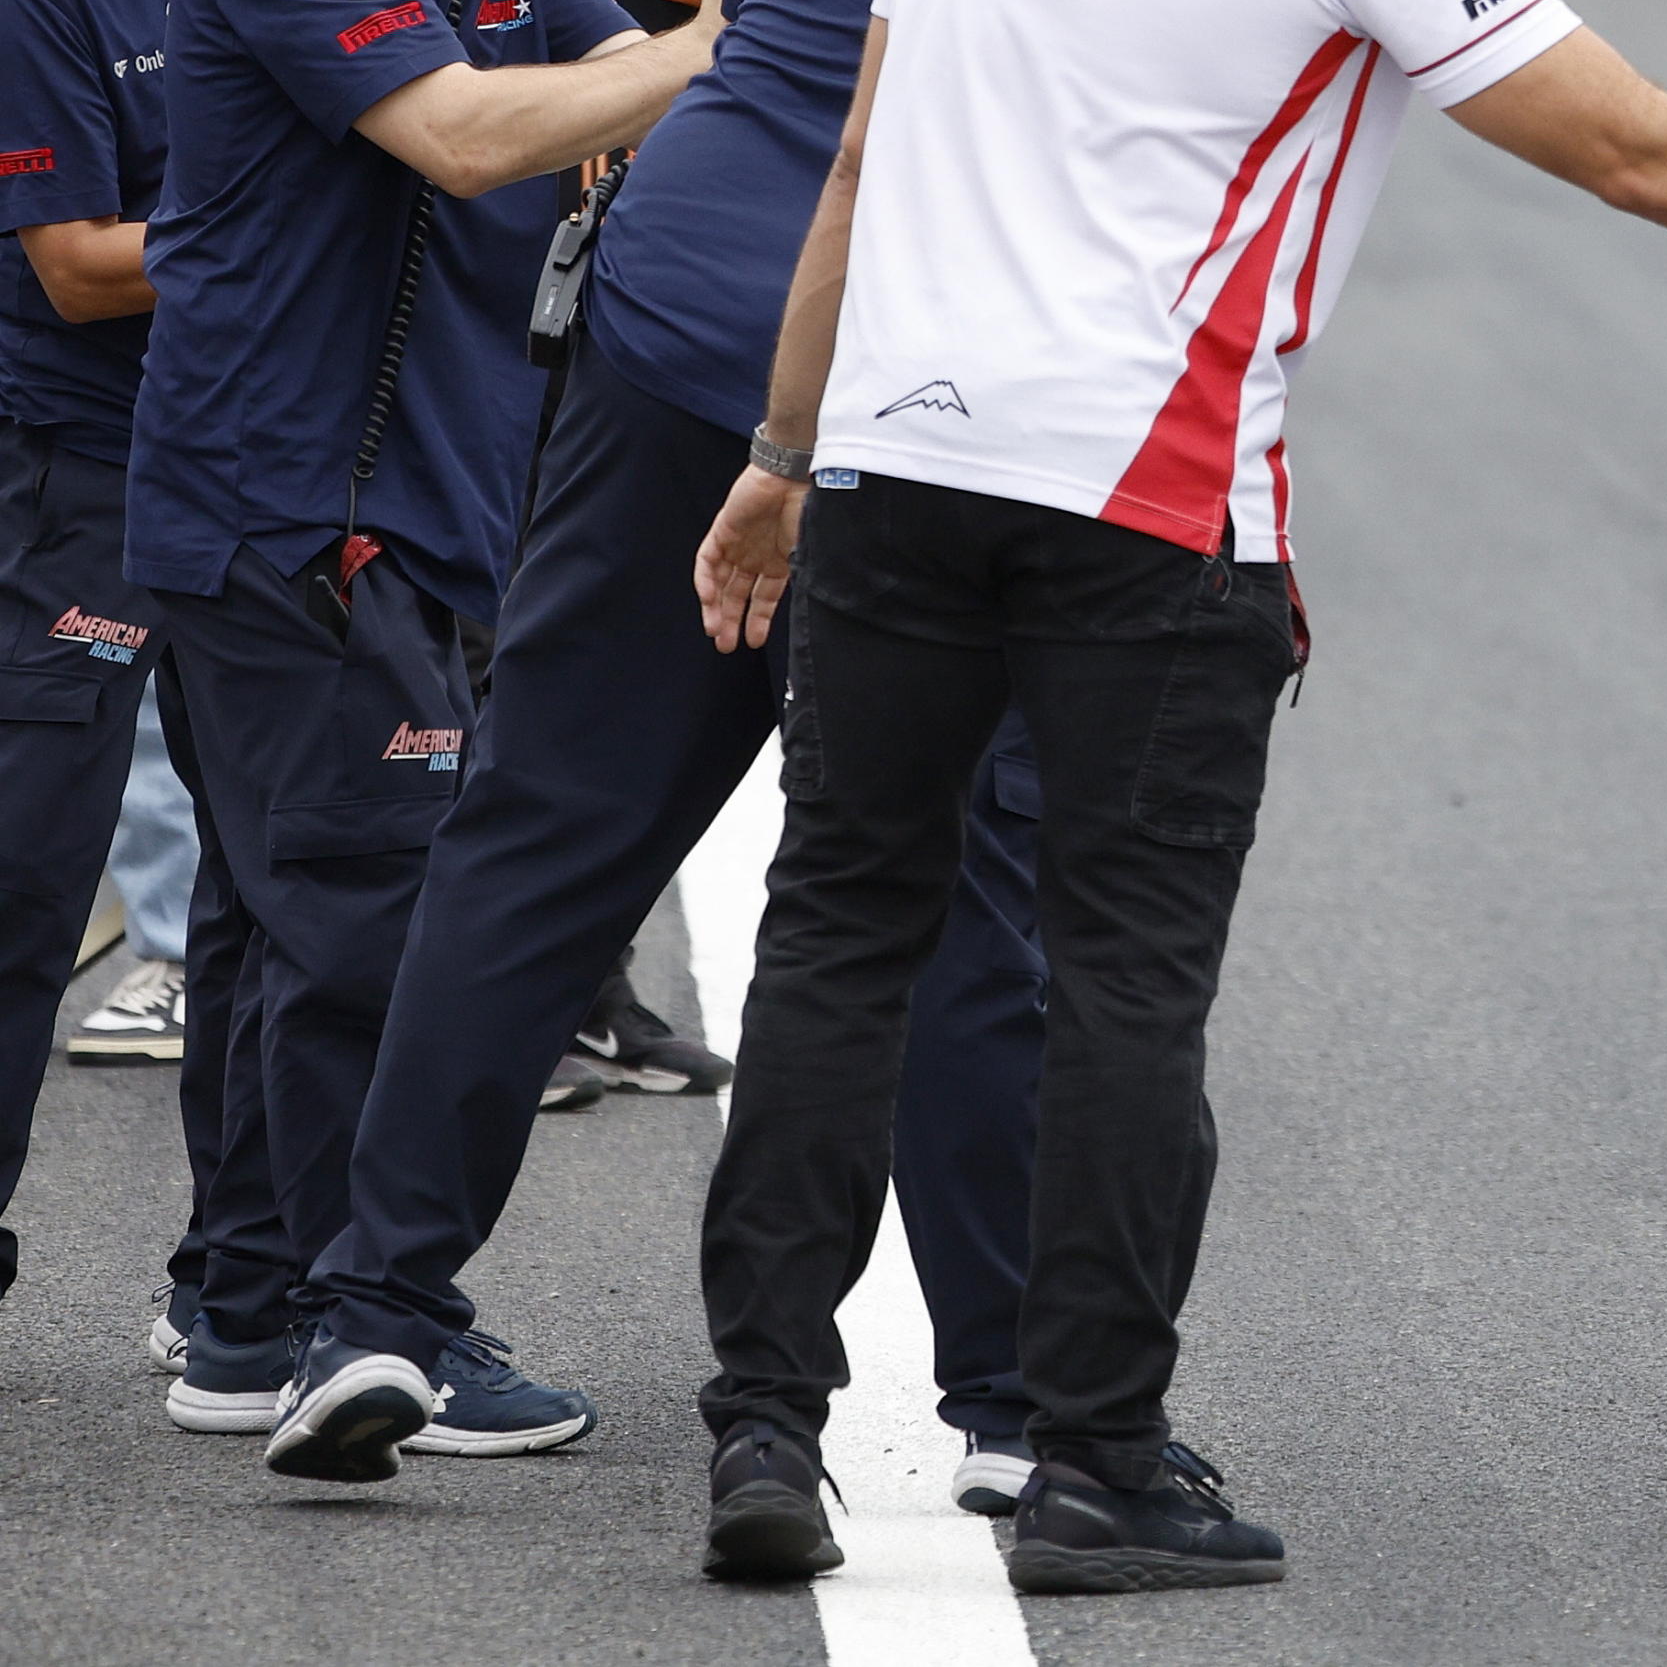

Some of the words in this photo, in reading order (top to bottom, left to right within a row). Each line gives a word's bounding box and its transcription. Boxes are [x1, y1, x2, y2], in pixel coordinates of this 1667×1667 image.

[336, 0, 428, 55] PIRELLI
[48, 605, 150, 650] AMERICAN
[88, 640, 139, 666] RACING
